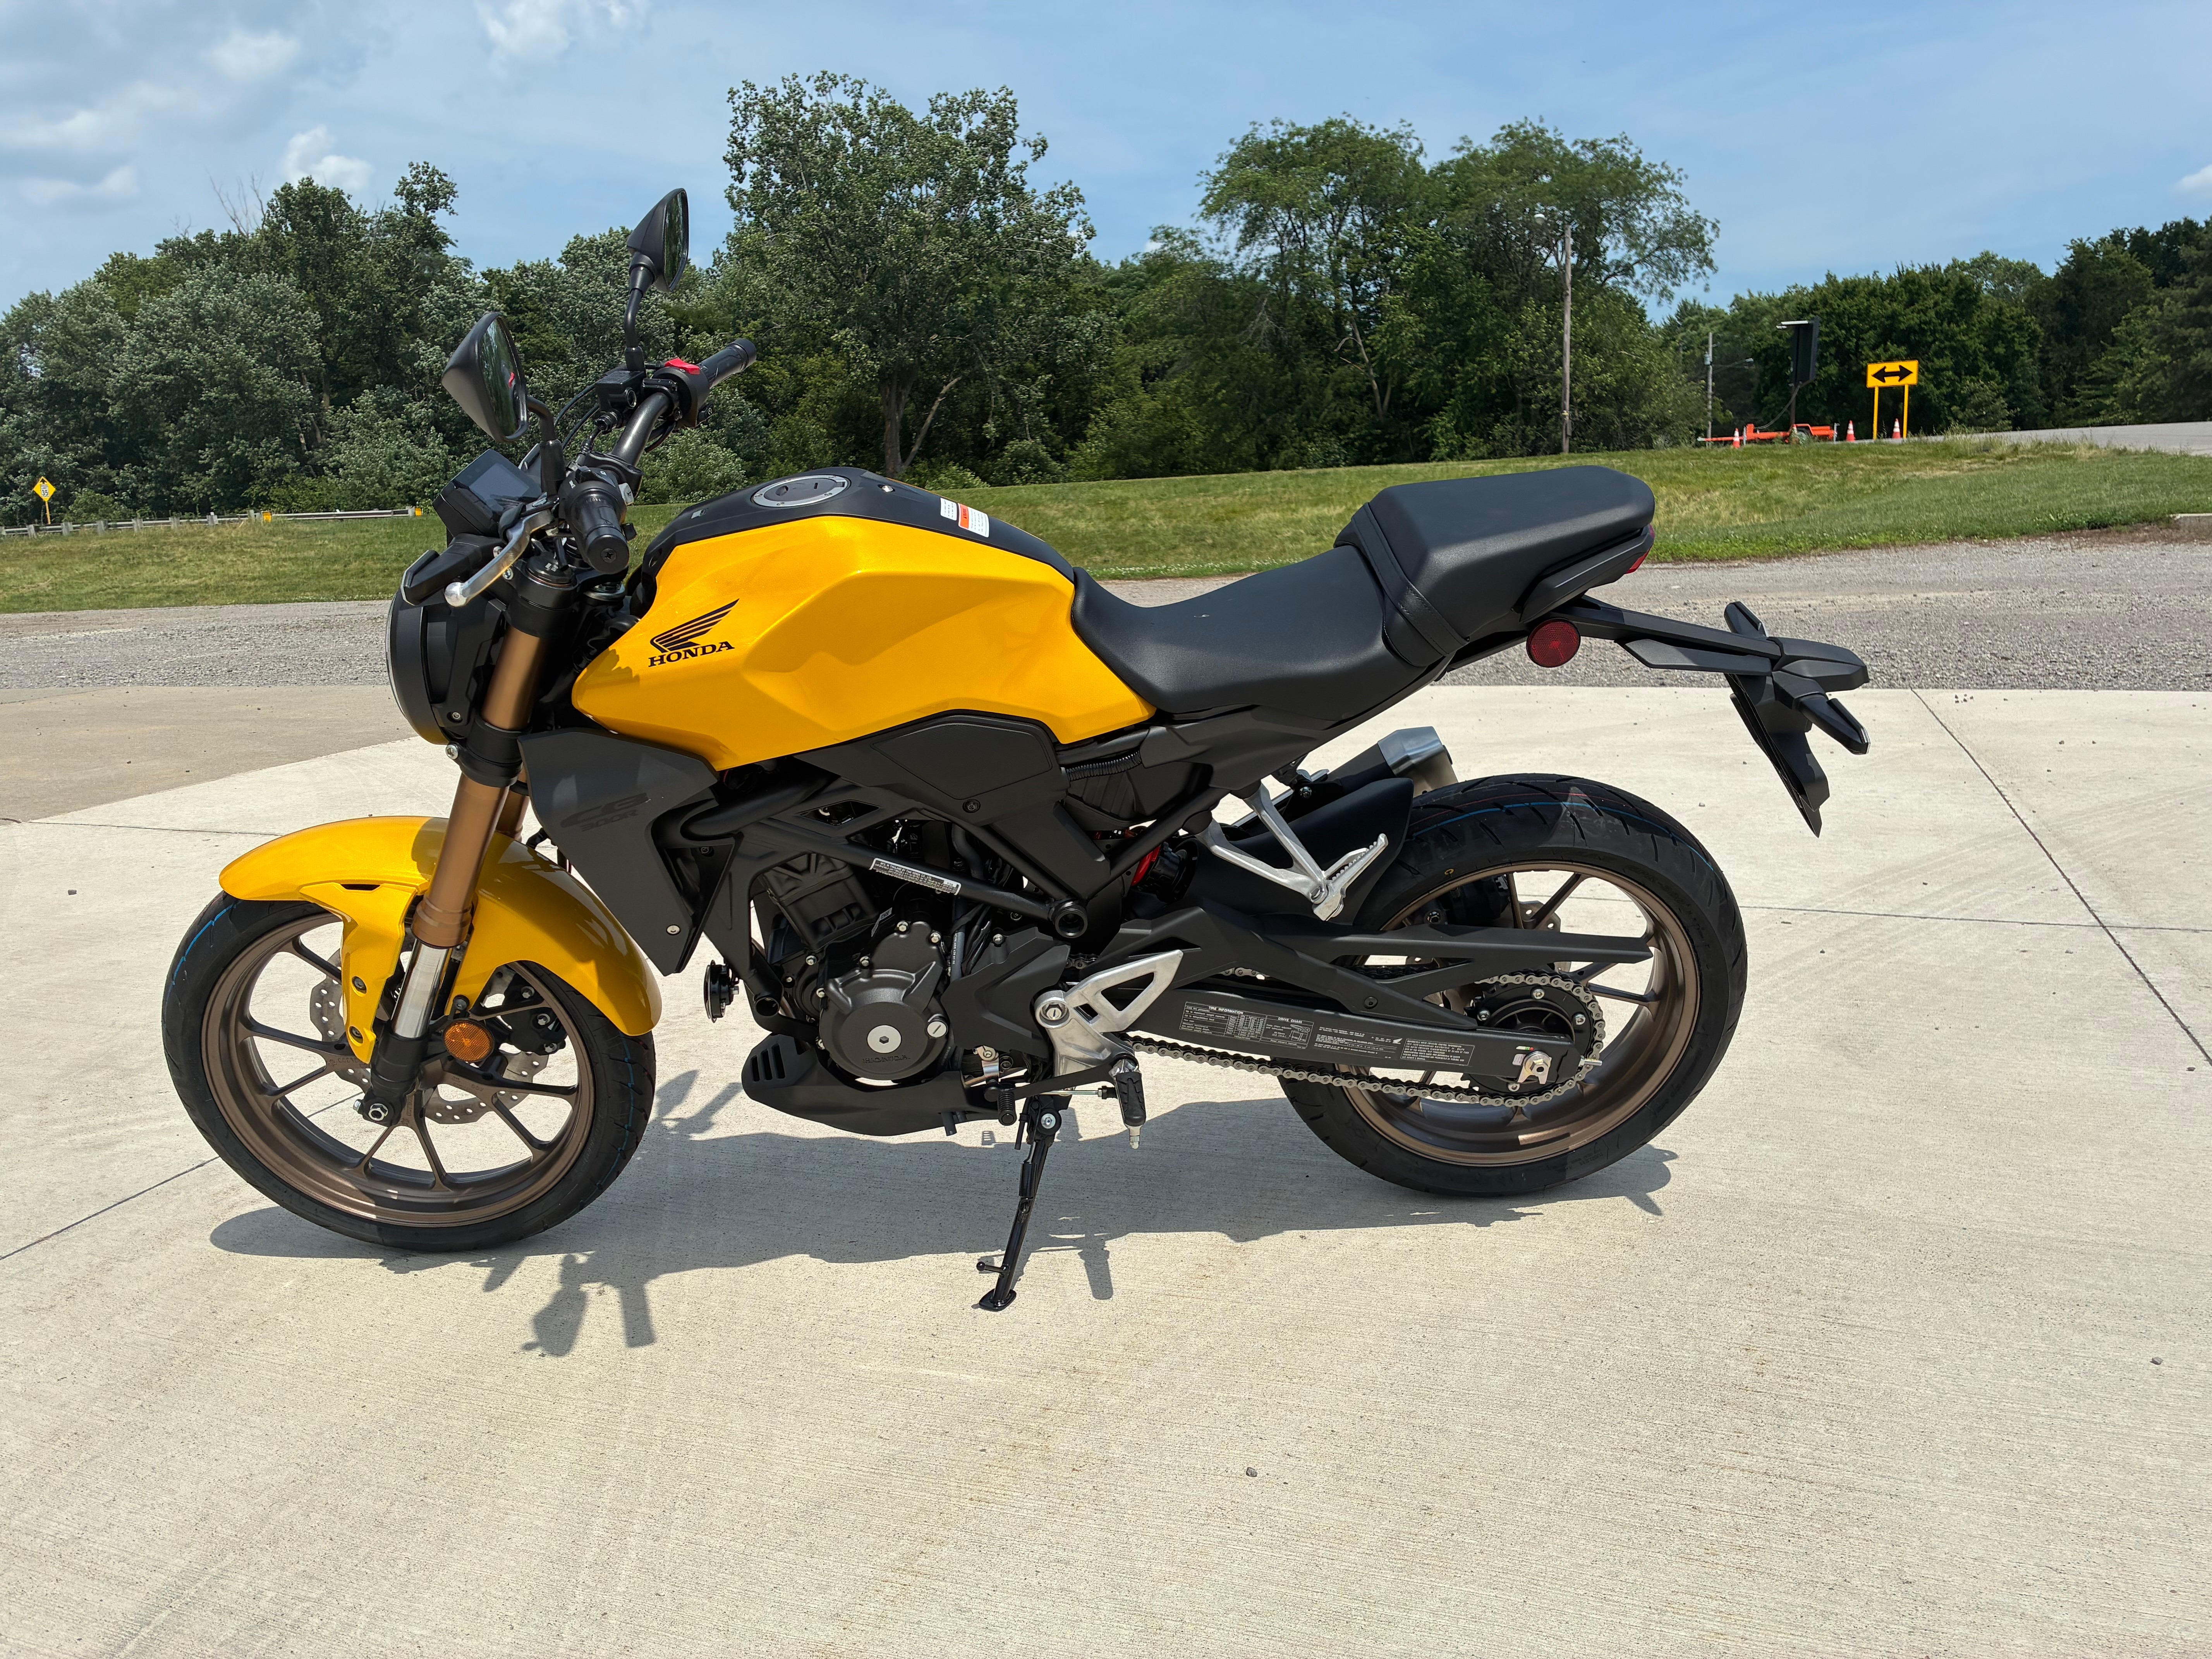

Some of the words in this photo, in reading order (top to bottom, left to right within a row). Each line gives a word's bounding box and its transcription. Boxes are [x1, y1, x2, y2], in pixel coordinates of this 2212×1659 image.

[648, 641, 735, 667] HONDA
[580, 809, 638, 831] 300R
[862, 1055, 911, 1063] HONDA
